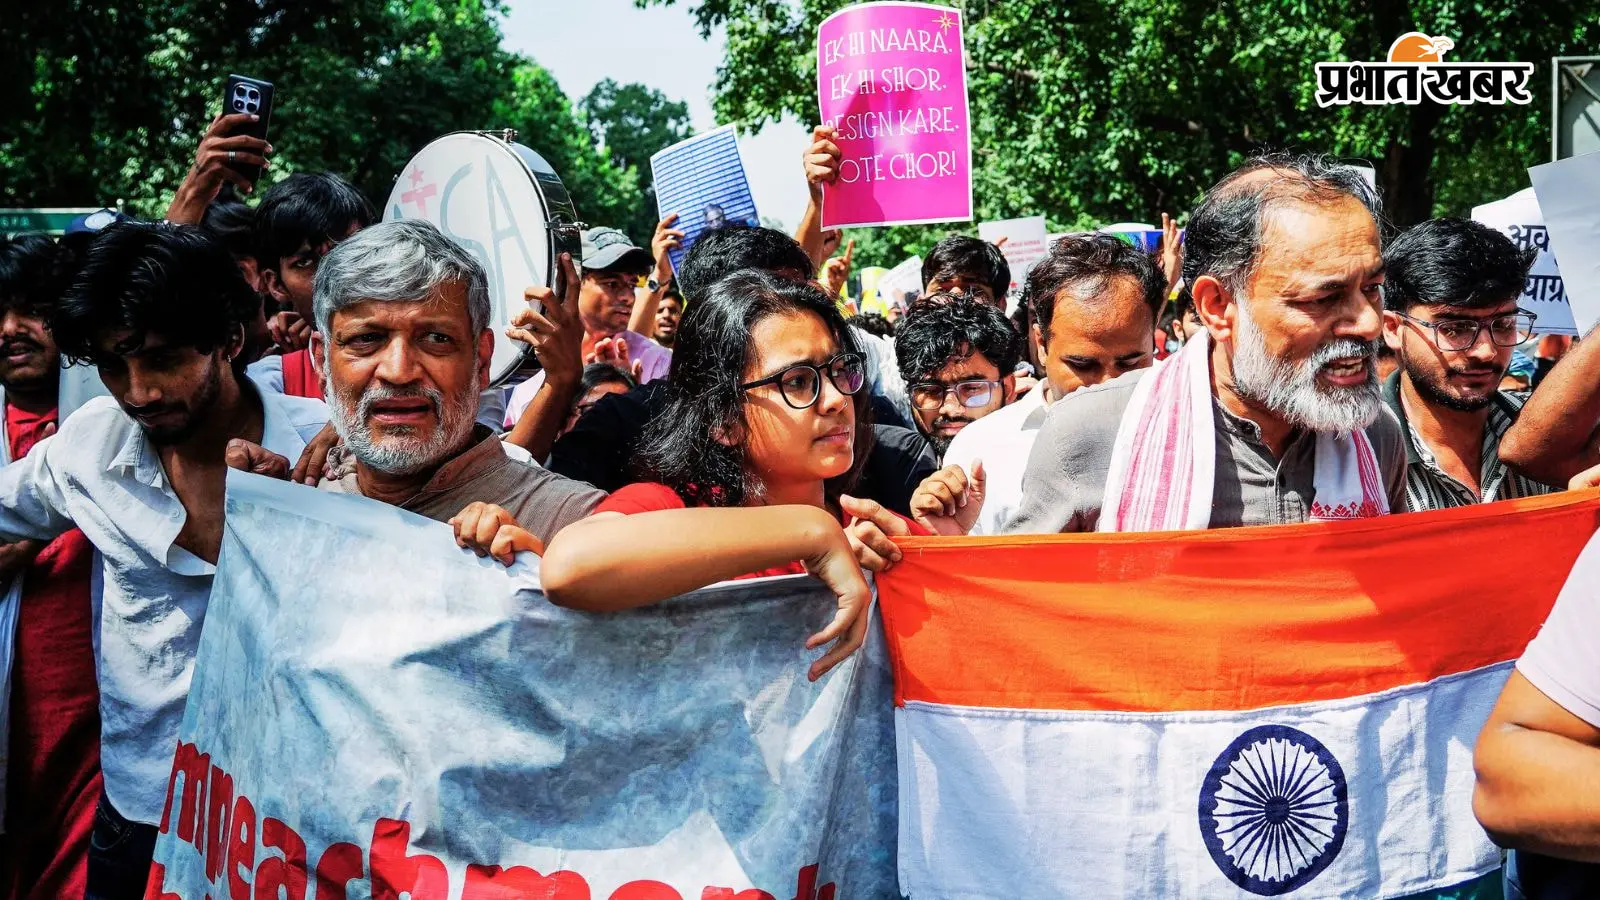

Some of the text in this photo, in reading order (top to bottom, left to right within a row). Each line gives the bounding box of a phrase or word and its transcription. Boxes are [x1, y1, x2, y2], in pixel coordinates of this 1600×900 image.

[824, 28, 953, 66] EK HI NAARA.
[830, 66, 947, 101] EK HI SHOR.
[898, 106, 960, 136] KARE.
[838, 150, 957, 183] OTE CHOR!
[1508, 224, 1550, 253] अव
